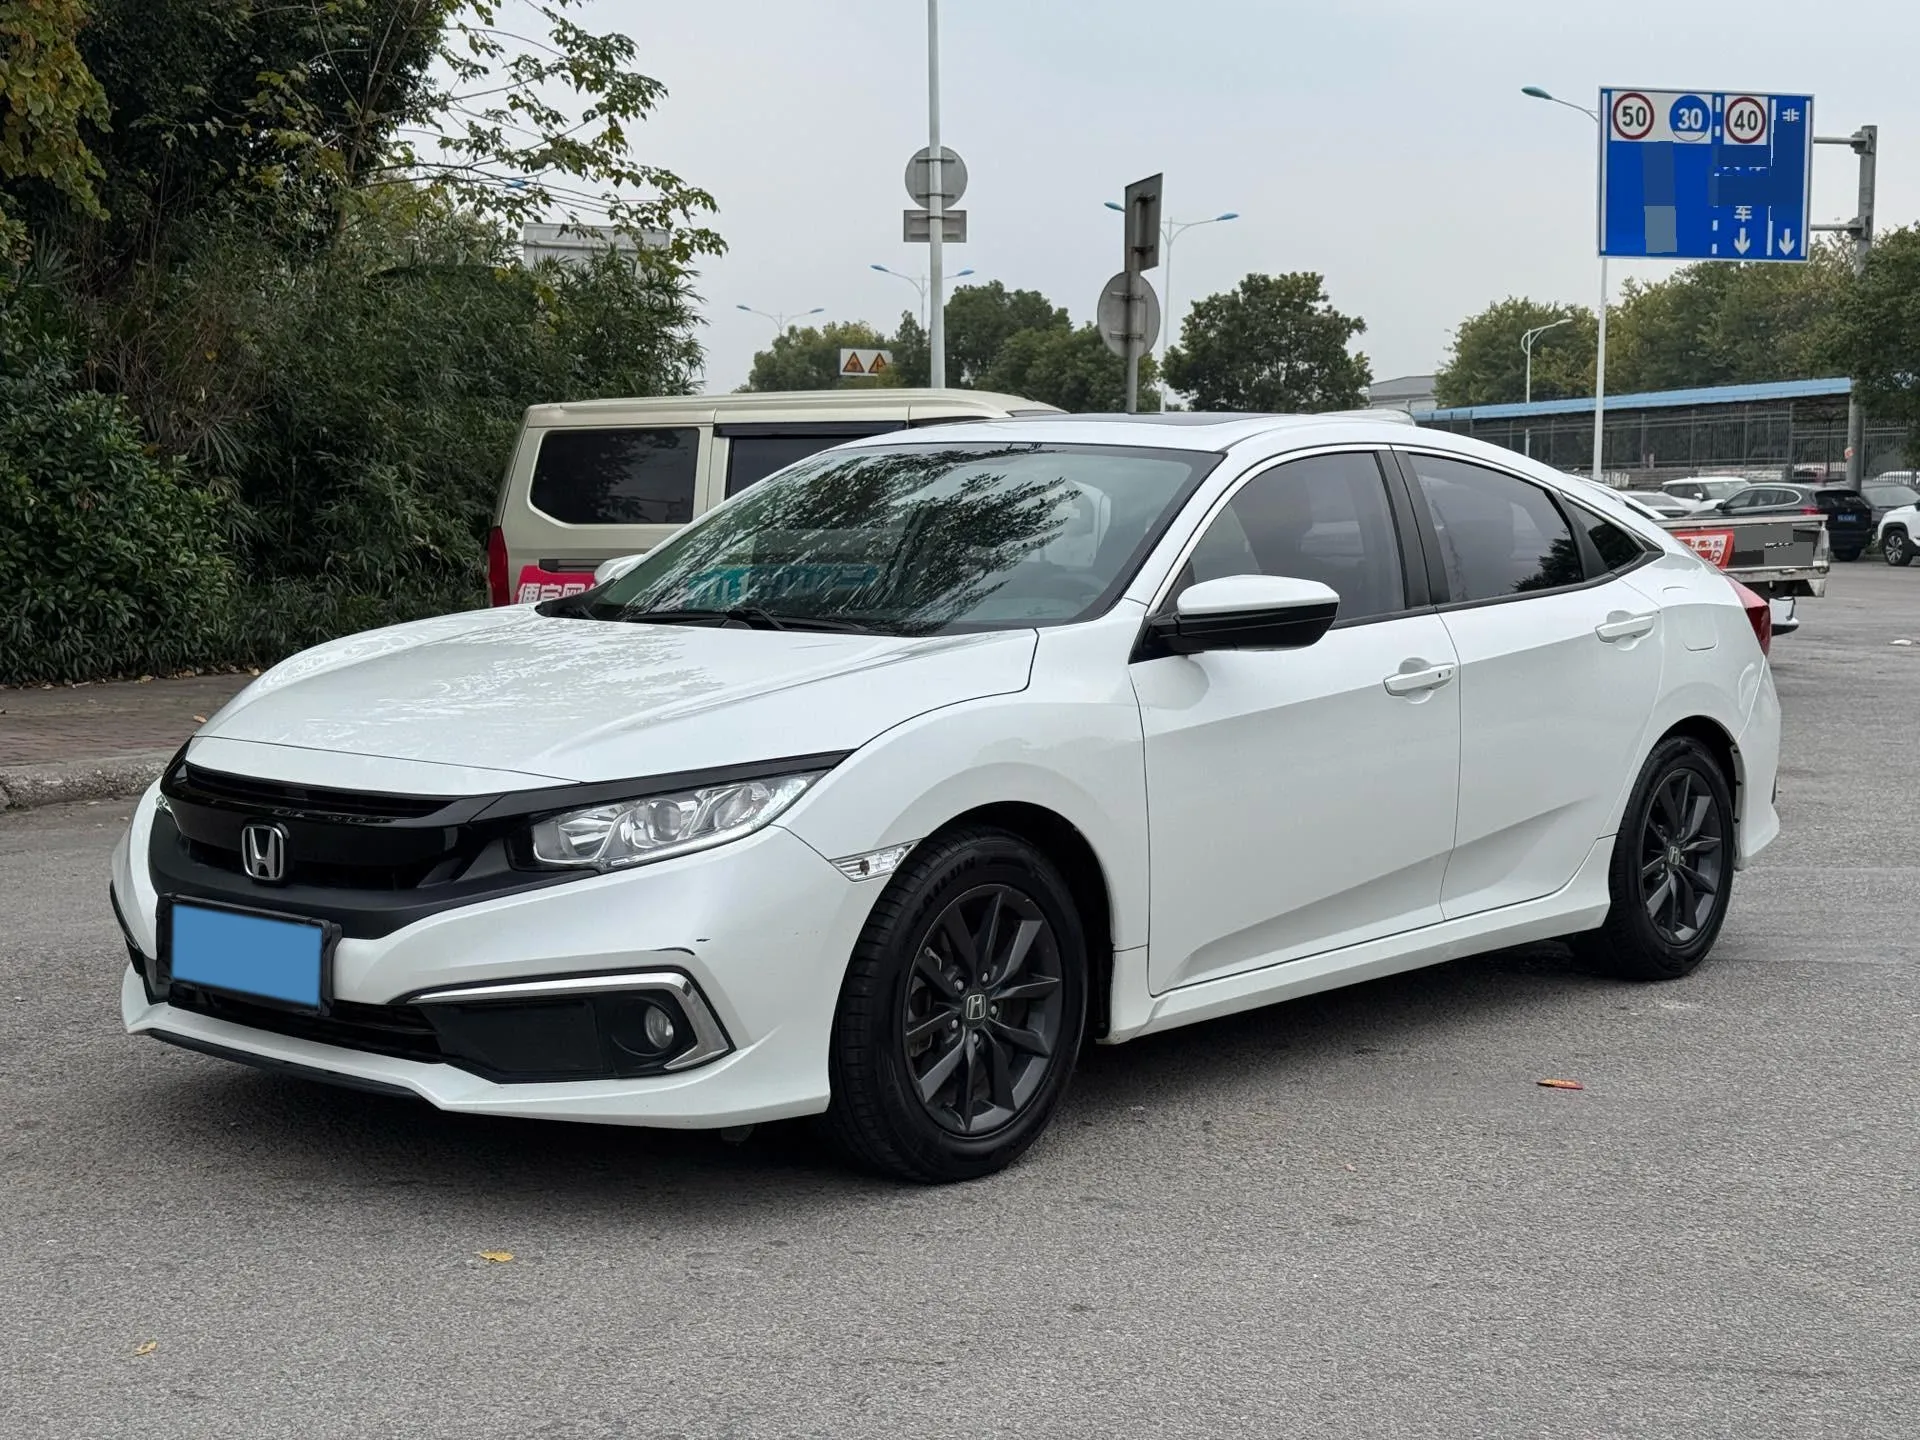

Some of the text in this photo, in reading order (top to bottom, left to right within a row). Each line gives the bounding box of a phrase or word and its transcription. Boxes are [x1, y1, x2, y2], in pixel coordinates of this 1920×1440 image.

[1622, 106, 1646, 127] 50
[1677, 108, 1703, 130] 30
[1733, 109, 1758, 131] 40
[517, 583, 594, 604] 便宜网
